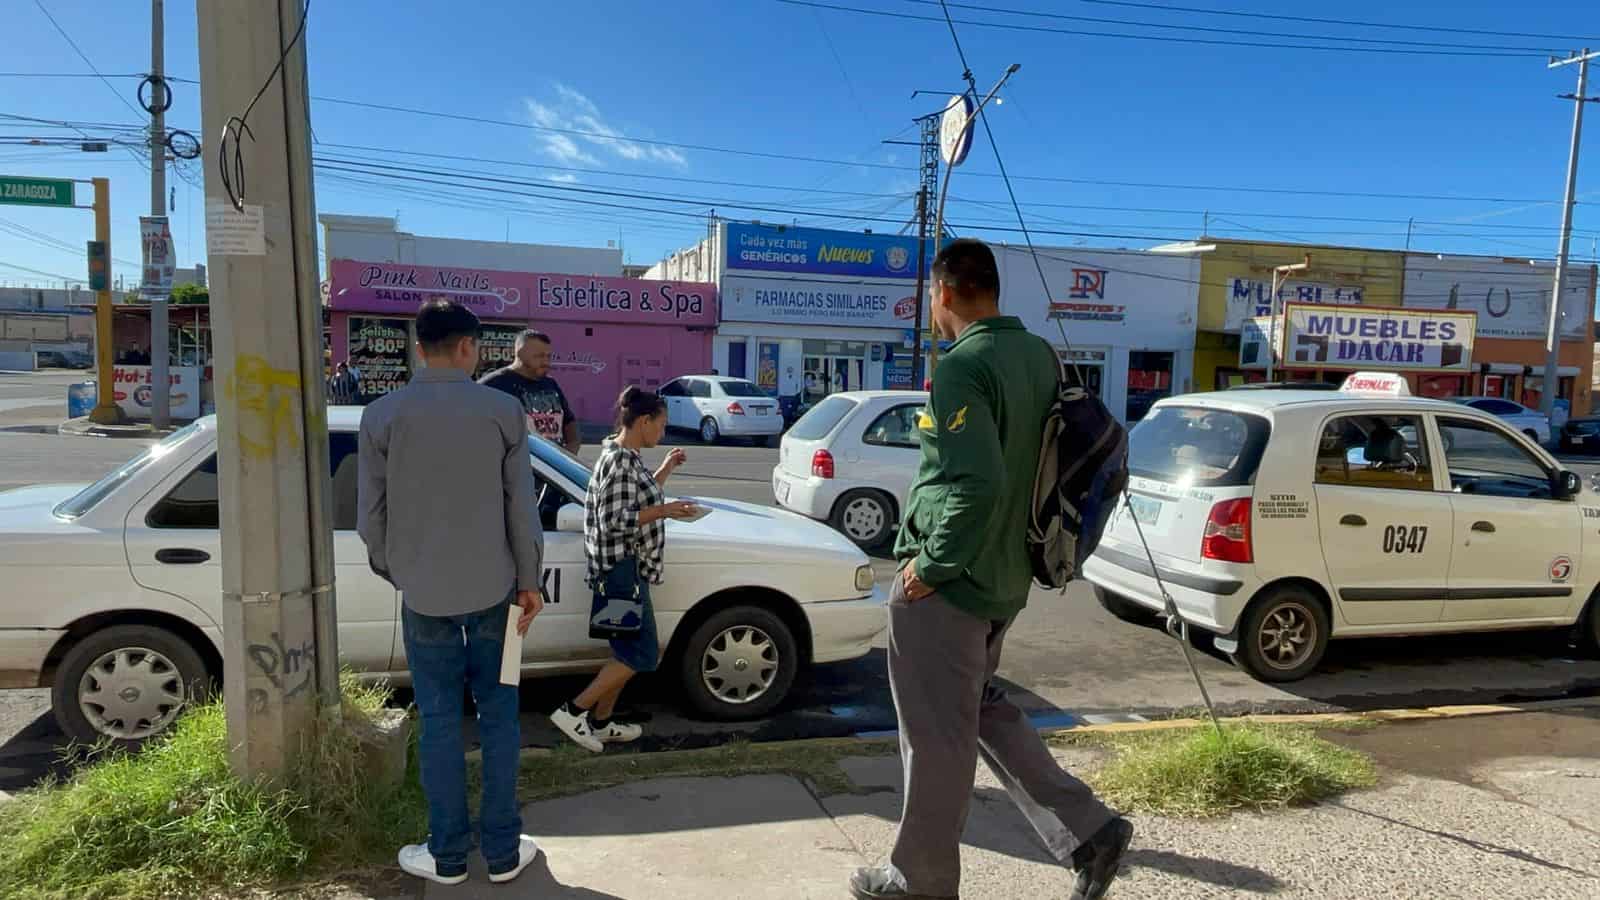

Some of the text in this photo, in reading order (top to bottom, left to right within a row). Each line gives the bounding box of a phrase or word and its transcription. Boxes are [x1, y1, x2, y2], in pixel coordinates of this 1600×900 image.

[5, 183, 57, 200] ZARAGOZA
[740, 233, 765, 248] Cada
[768, 238, 786, 249] vez
[817, 244, 874, 264] Nuevos
[360, 266, 489, 290] Pink Nails
[538, 277, 702, 318] Estetica & Spa
[755, 290, 887, 311] FARMACIAS SIMILARES
[1308, 315, 1456, 340] MUEBLES
[1337, 339, 1425, 363] DACAR
[1383, 525, 1428, 554] 0347
